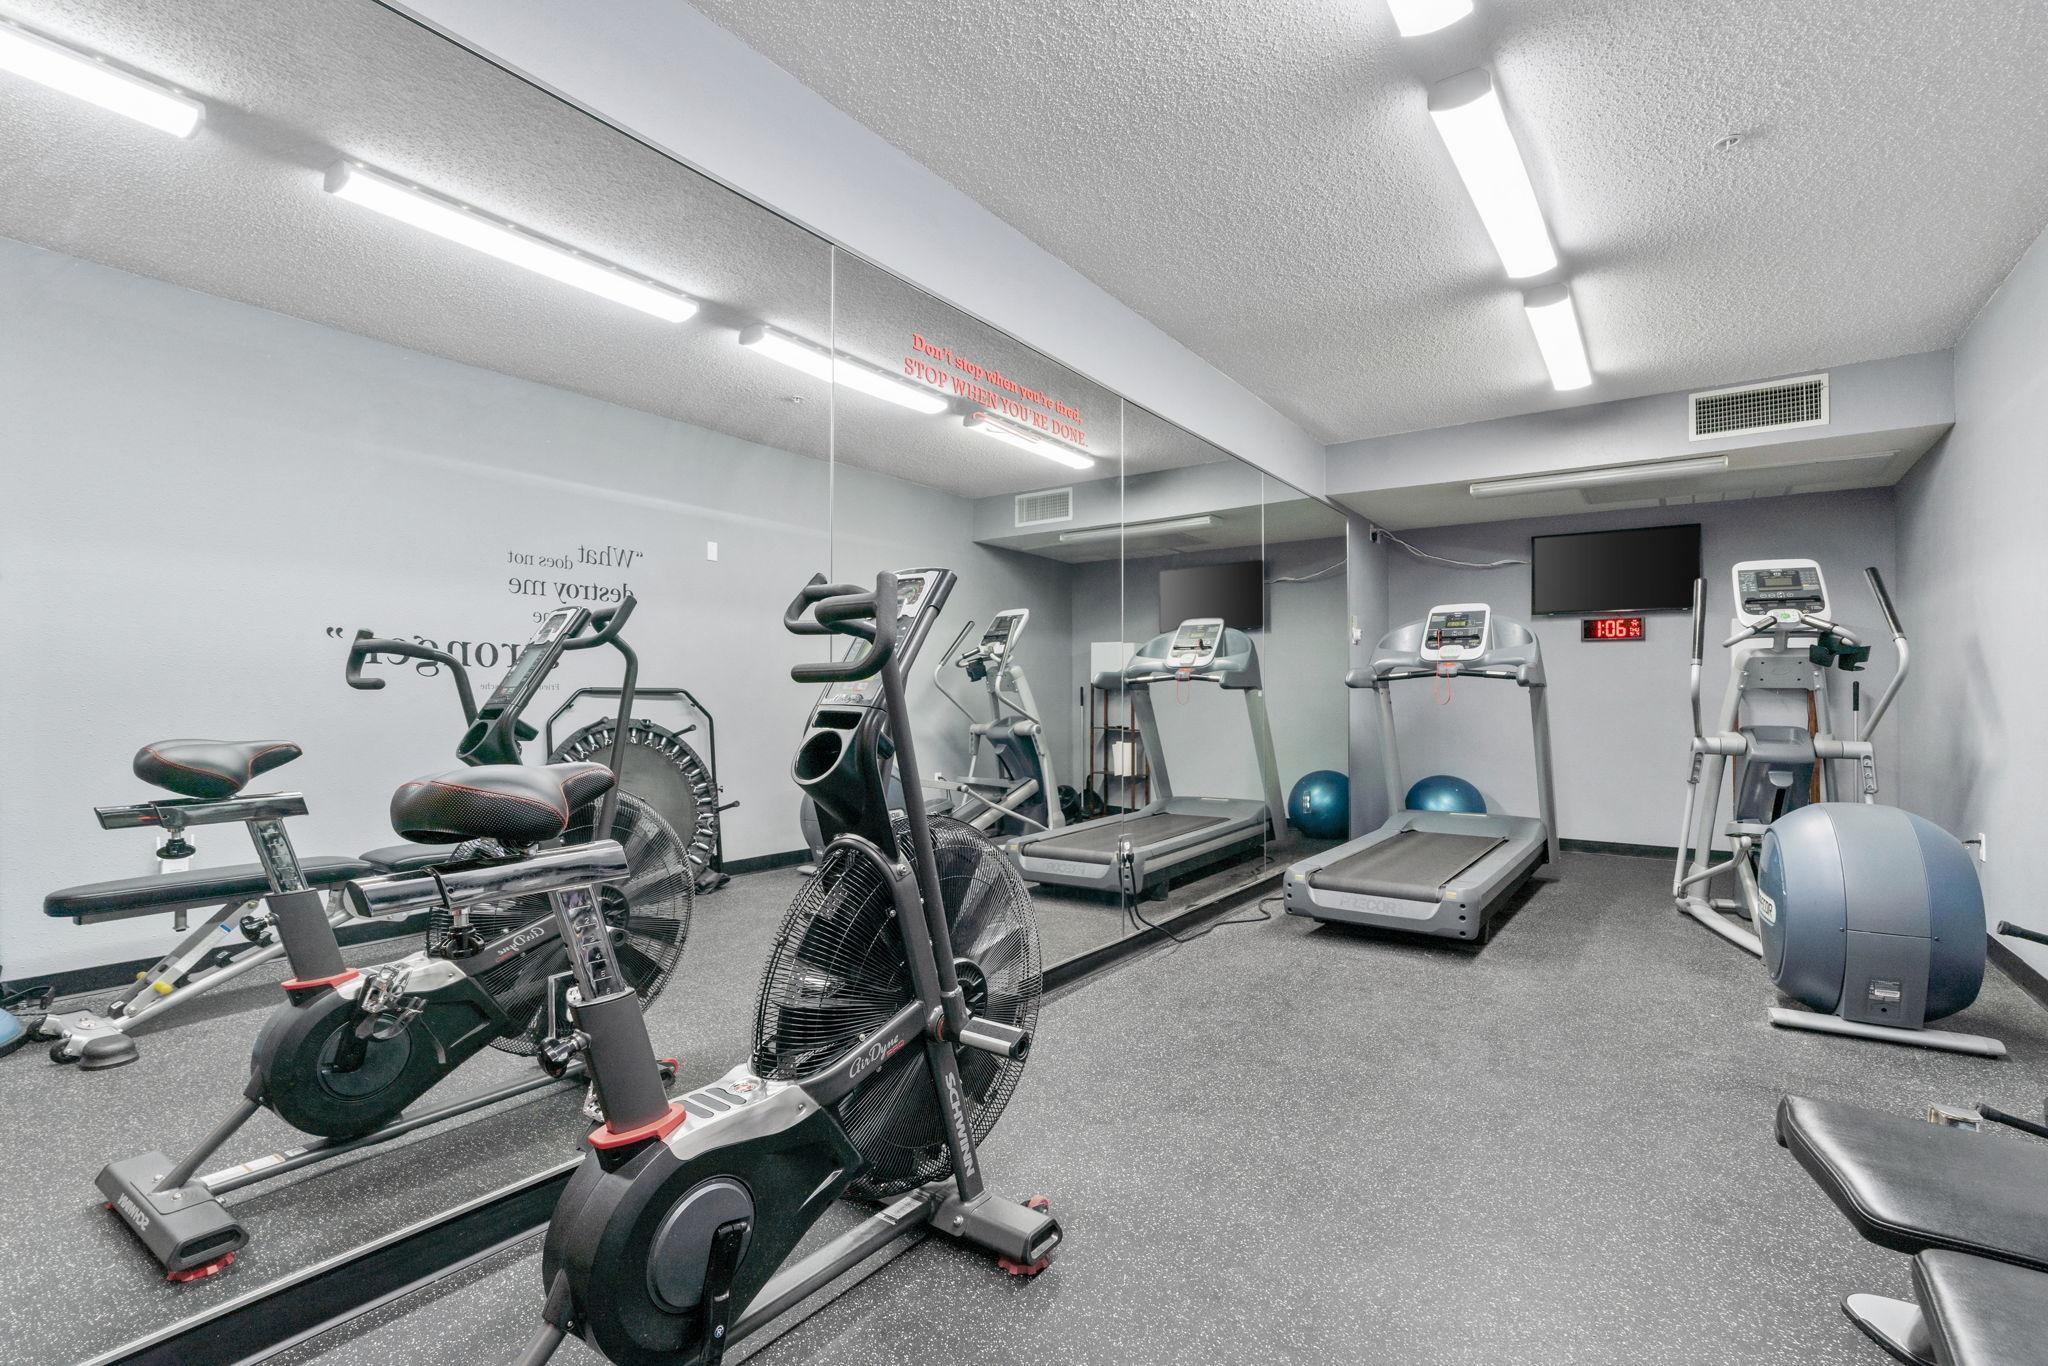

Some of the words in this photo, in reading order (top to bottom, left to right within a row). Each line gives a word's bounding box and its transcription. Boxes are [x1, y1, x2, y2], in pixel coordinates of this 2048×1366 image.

[904, 357, 948, 388] STOP
[952, 376, 999, 410] WHEN
[1000, 397, 1048, 431] YOU'RE
[1052, 419, 1089, 447] DONE.
[912, 332, 953, 366] Don't
[955, 356, 983, 379] stop
[985, 369, 1017, 394] when
[1020, 386, 1053, 408] you're
[1597, 620, 1626, 637] 1:06
[849, 1034, 900, 1079] AirDyne
[944, 1071, 976, 1178] SCHWINN
